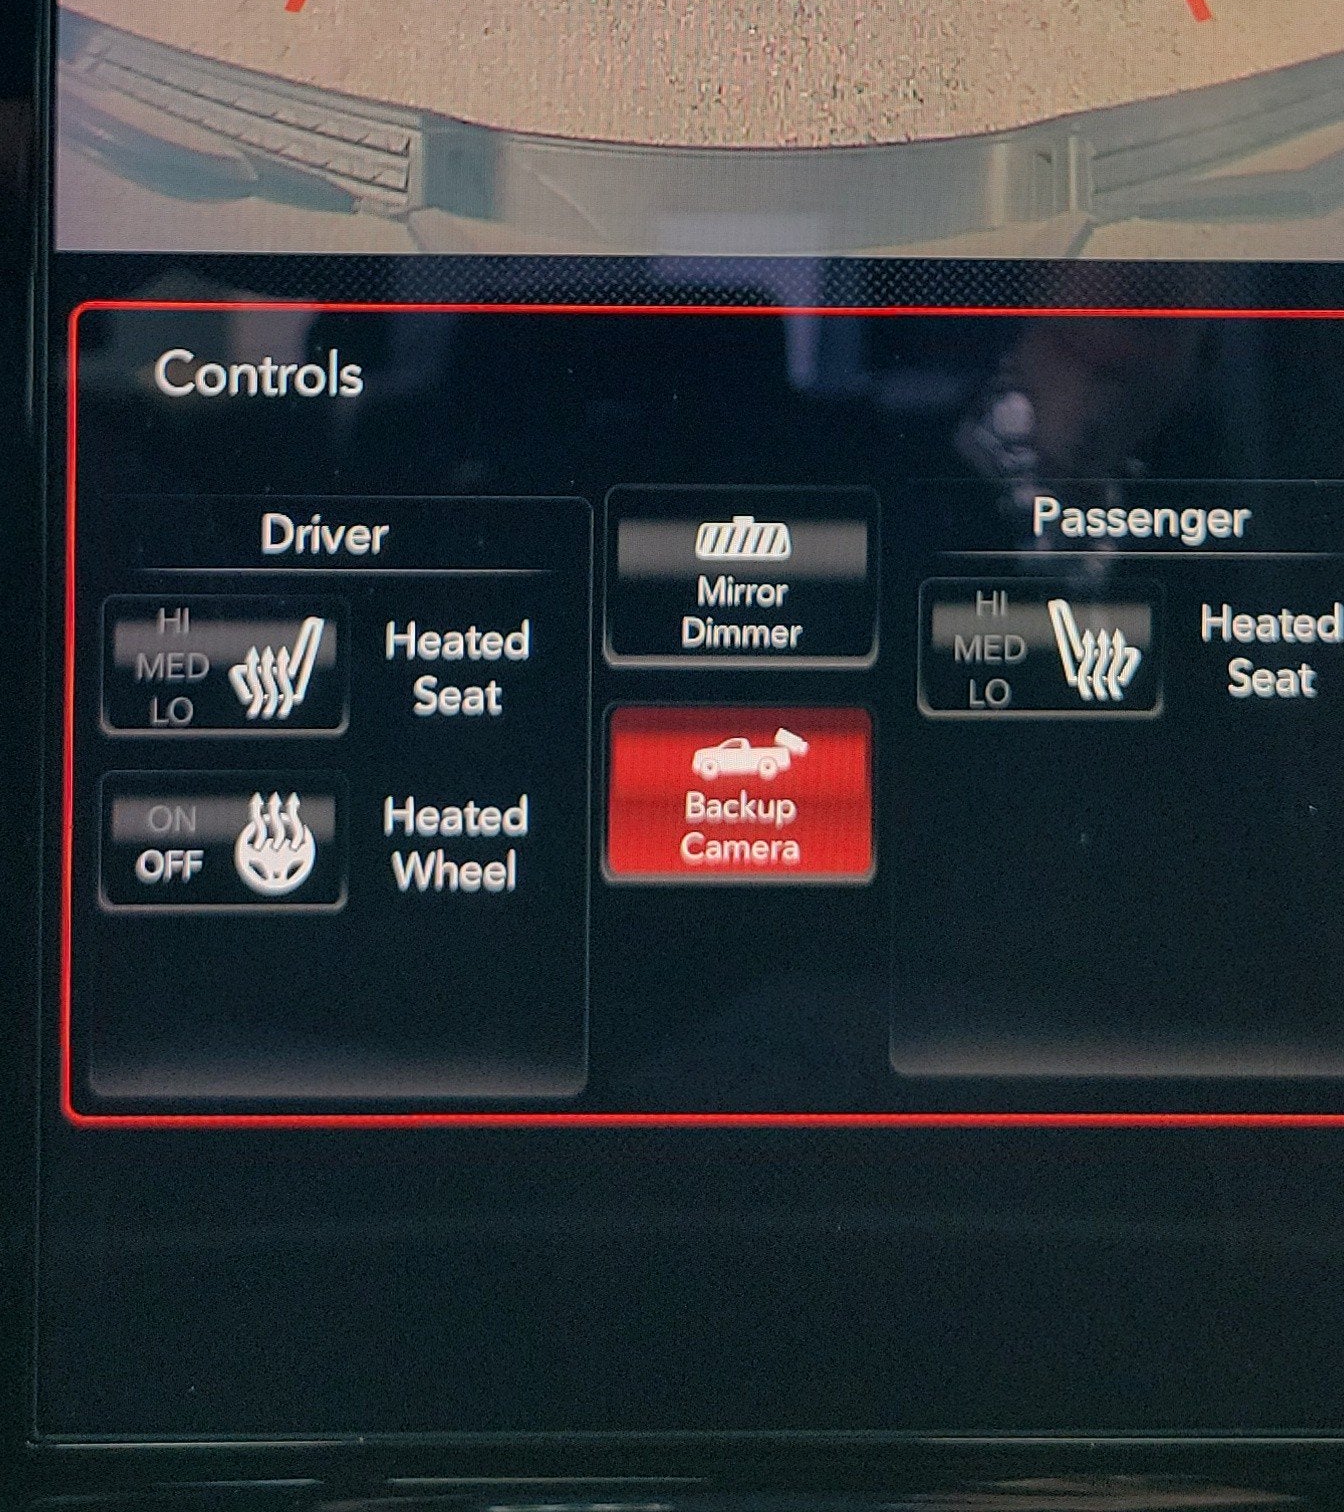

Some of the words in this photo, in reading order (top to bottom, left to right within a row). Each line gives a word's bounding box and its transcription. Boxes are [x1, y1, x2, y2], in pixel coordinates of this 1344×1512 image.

[154, 347, 364, 398] Controls
[261, 512, 391, 555] Driver
[1032, 495, 1253, 547] Passenger
[697, 574, 790, 608] Mirror
[975, 590, 1009, 617] HI
[156, 607, 191, 635] HI
[681, 616, 804, 649] Dimmer
[385, 618, 532, 661] Heated
[955, 634, 1027, 664] MED
[136, 652, 210, 682] MED
[1227, 658, 1318, 699] Seat
[413, 675, 503, 717] Seat
[968, 678, 1012, 710] LO
[150, 697, 194, 727] LO
[147, 805, 197, 833] ON
[383, 794, 530, 838] Heated
[684, 791, 798, 830] Backup
[680, 831, 802, 864] Camera
[135, 850, 204, 884] OFF
[390, 849, 517, 893] Wheel
